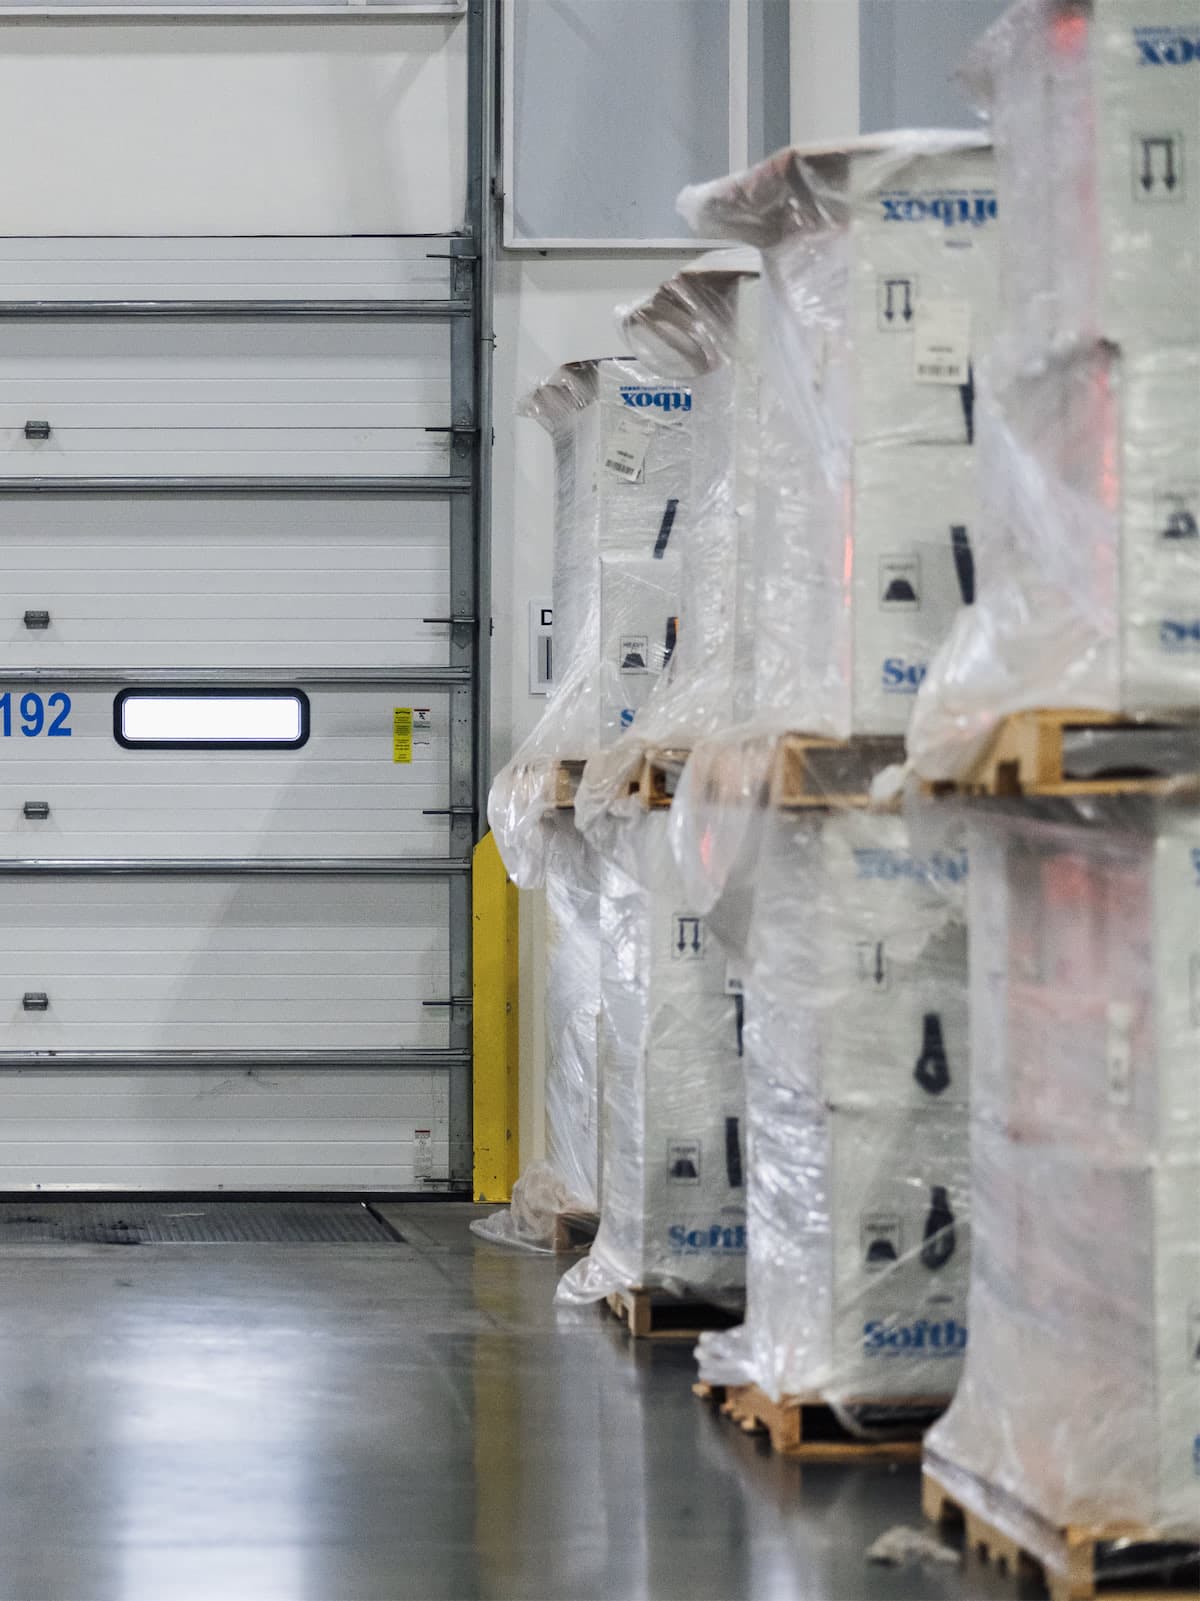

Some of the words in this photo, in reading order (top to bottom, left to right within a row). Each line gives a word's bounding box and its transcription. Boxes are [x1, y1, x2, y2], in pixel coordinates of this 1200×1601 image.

[882, 198, 997, 227] ftbox
[620, 392, 692, 411] ftbox
[668, 1224, 746, 1249] Soft
[864, 1319, 968, 1348] Softb
